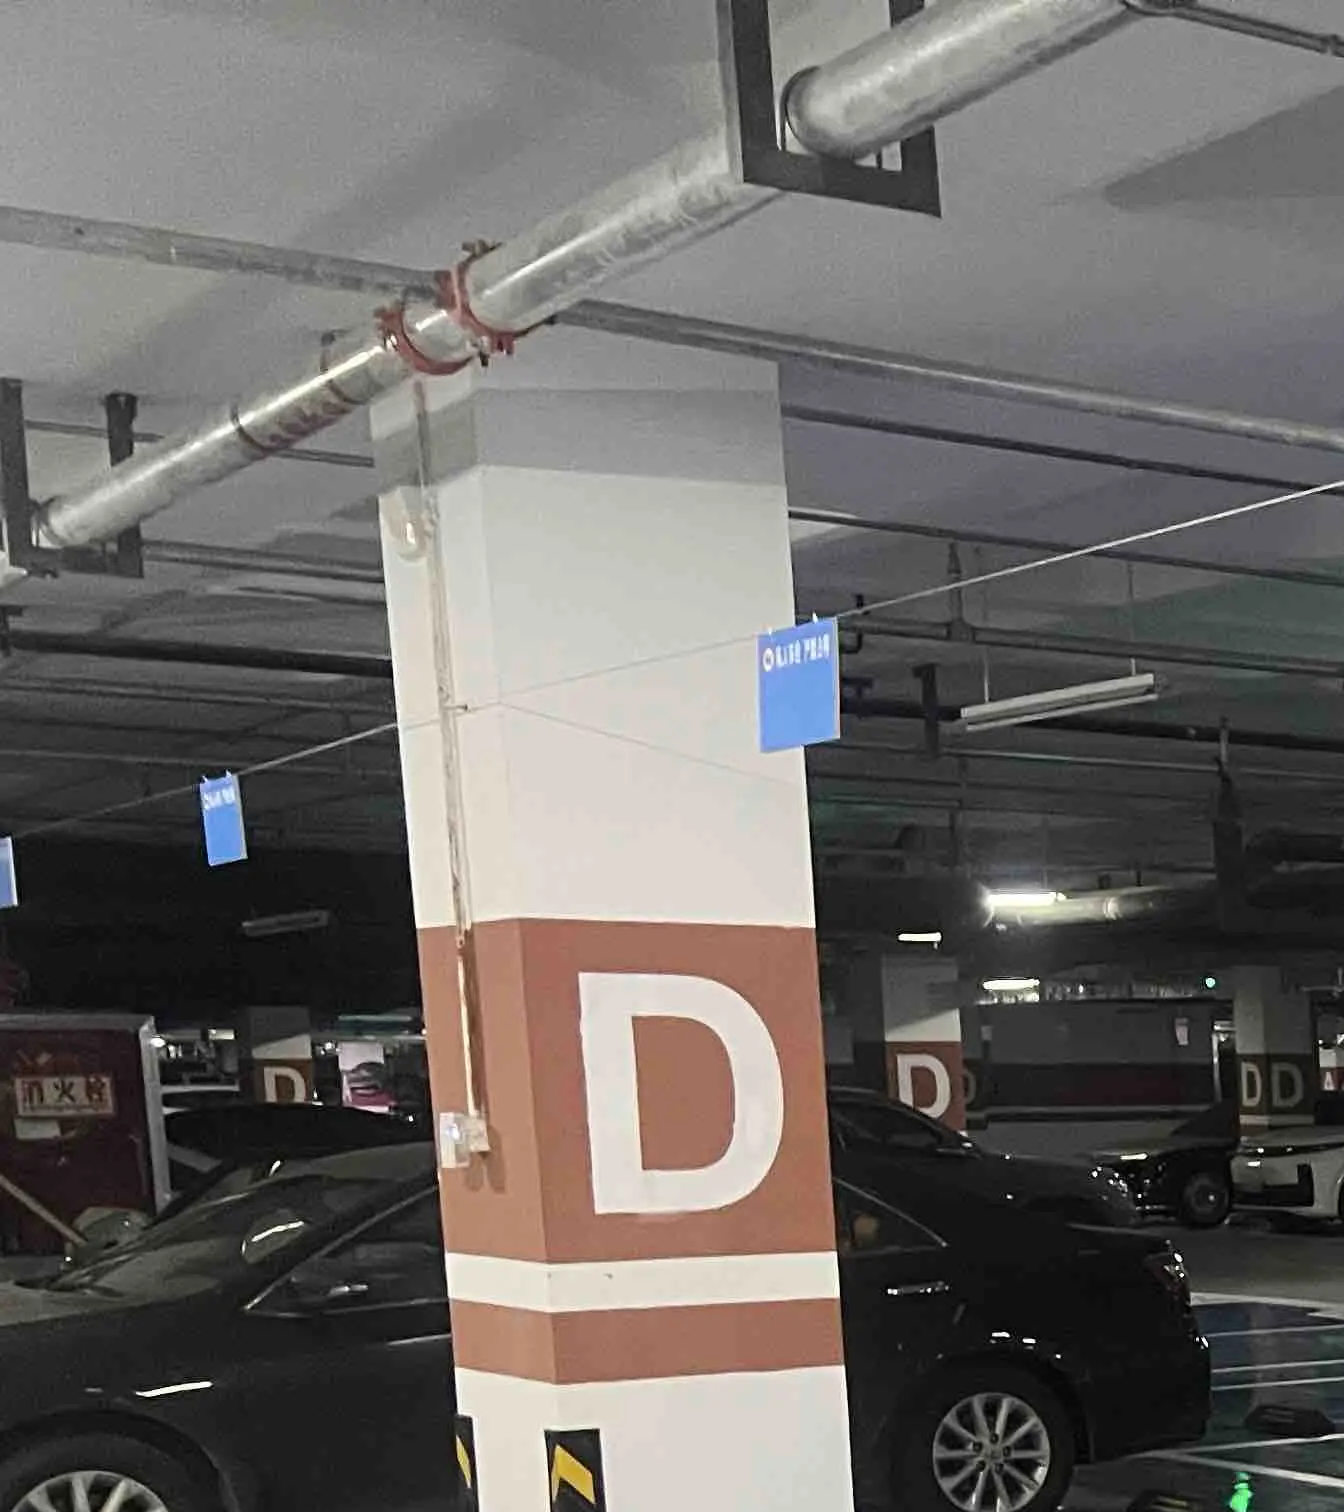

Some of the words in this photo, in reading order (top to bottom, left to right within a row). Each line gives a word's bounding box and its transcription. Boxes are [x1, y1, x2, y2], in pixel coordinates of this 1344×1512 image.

[263, 1065, 308, 1104] D
[578, 971, 784, 1214] D
[896, 1053, 951, 1119] D
[1241, 1061, 1262, 1107] D
[1271, 1061, 1304, 1108] D
